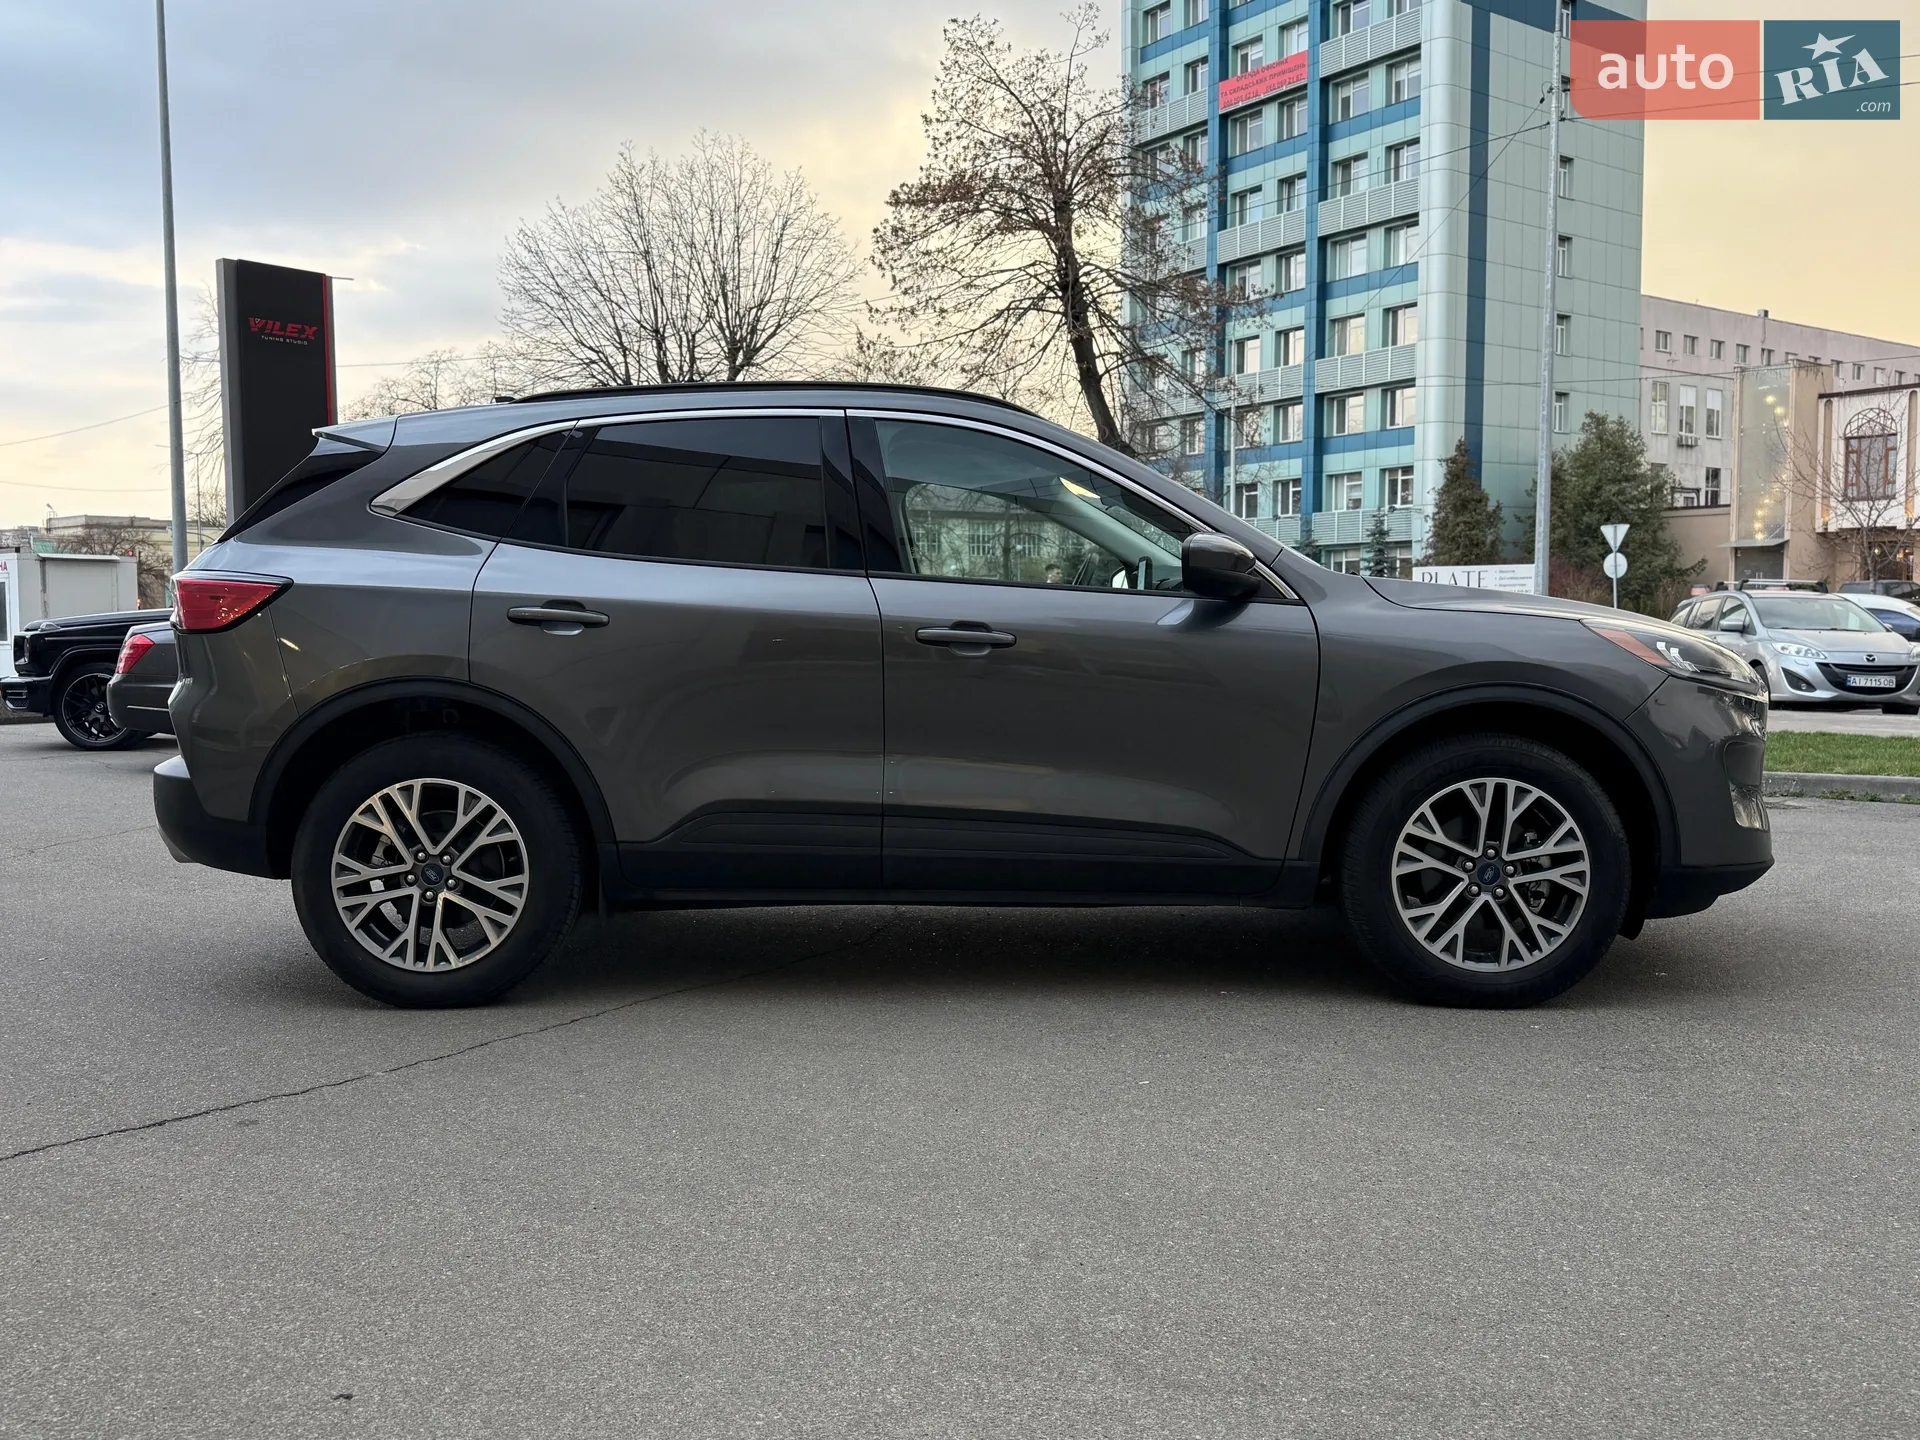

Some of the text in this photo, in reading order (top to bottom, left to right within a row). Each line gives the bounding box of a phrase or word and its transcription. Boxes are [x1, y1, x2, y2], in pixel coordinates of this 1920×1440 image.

[1236, 69, 1260, 82] ОРЕНДА
[1228, 76, 1268, 96] СКЛАДСЬКИХ
[248, 317, 318, 340] VILEX
[285, 338, 308, 346] STUDIO
